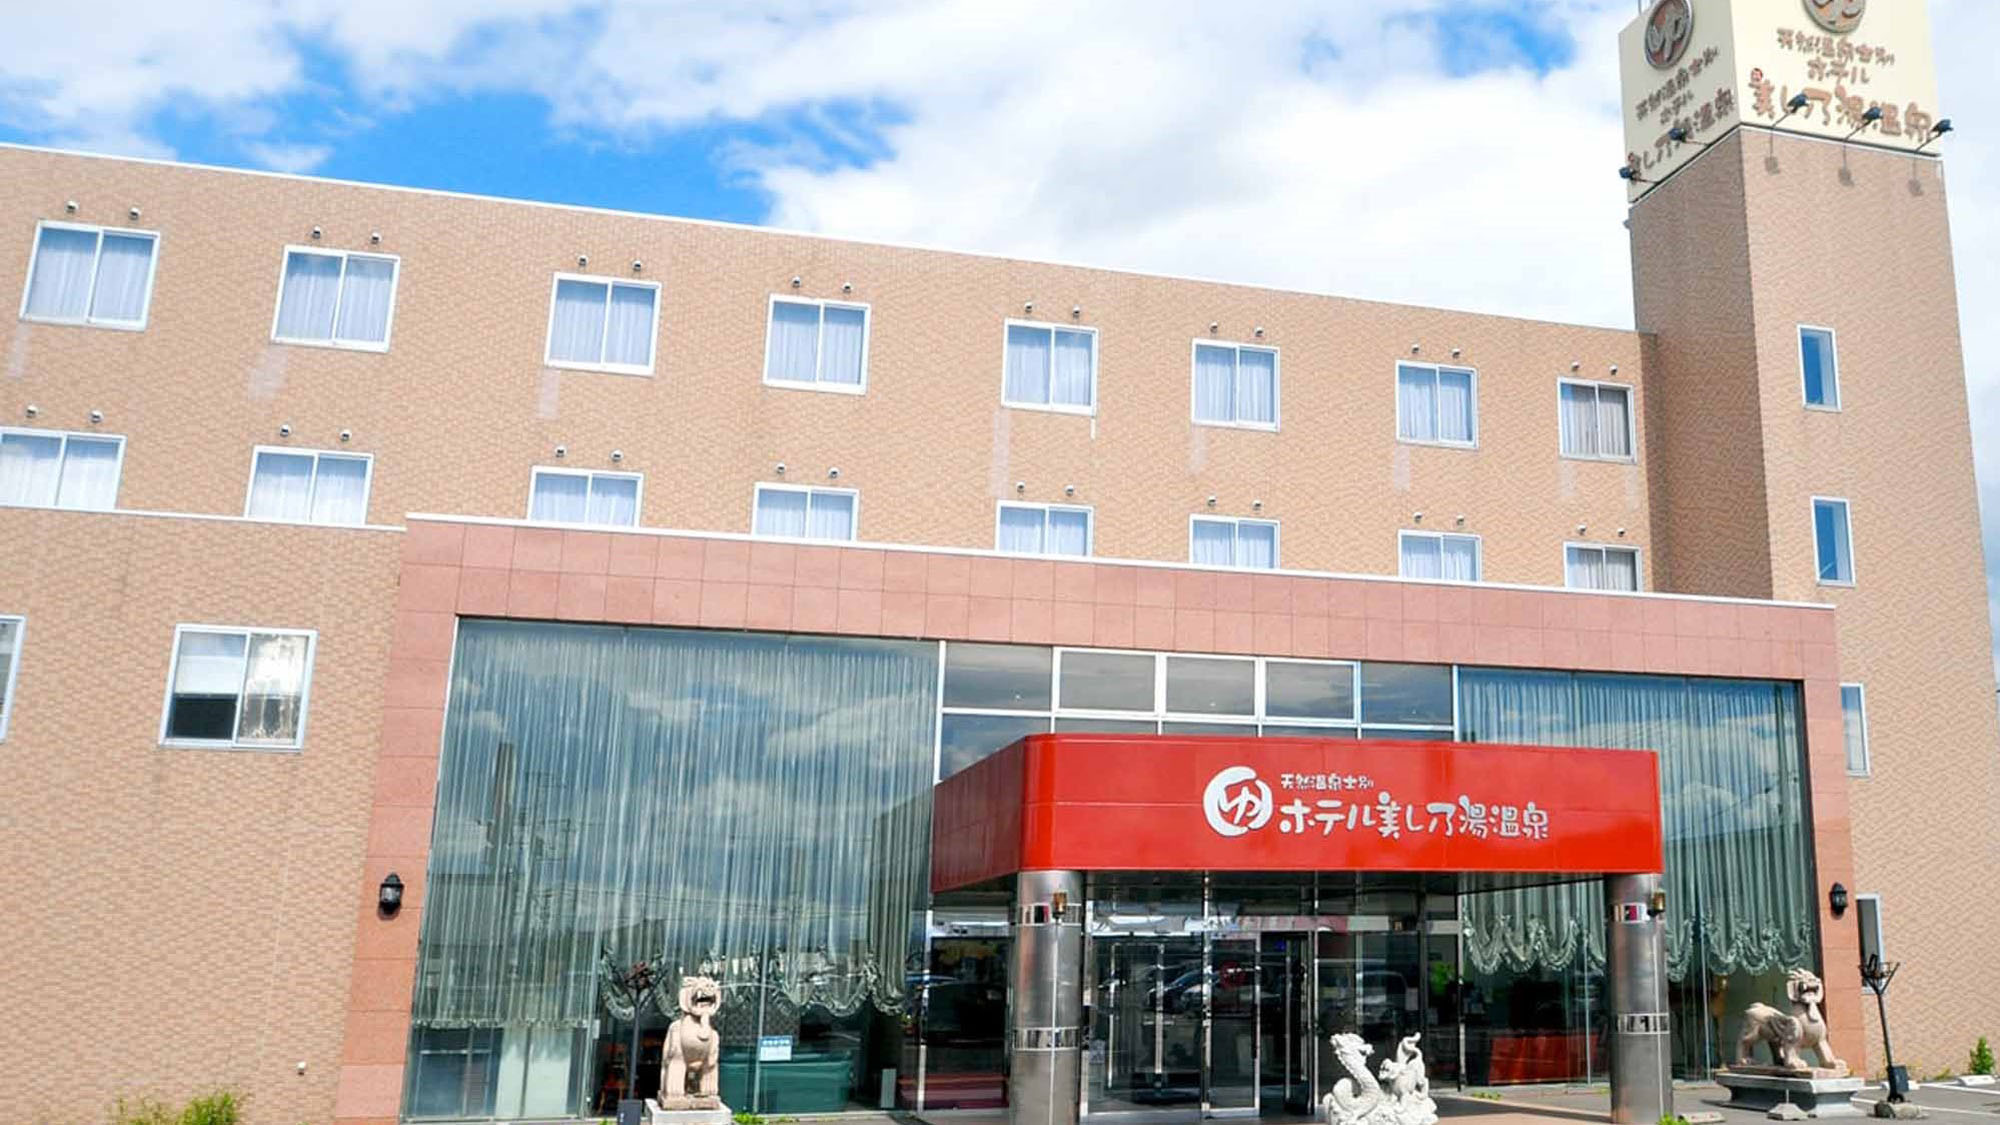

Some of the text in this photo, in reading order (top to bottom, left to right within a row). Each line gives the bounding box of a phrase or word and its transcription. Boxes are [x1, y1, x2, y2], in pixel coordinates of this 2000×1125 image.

[1807, 57, 1870, 84] ホテル
[1280, 773, 1374, 790] 天然温泉士別
